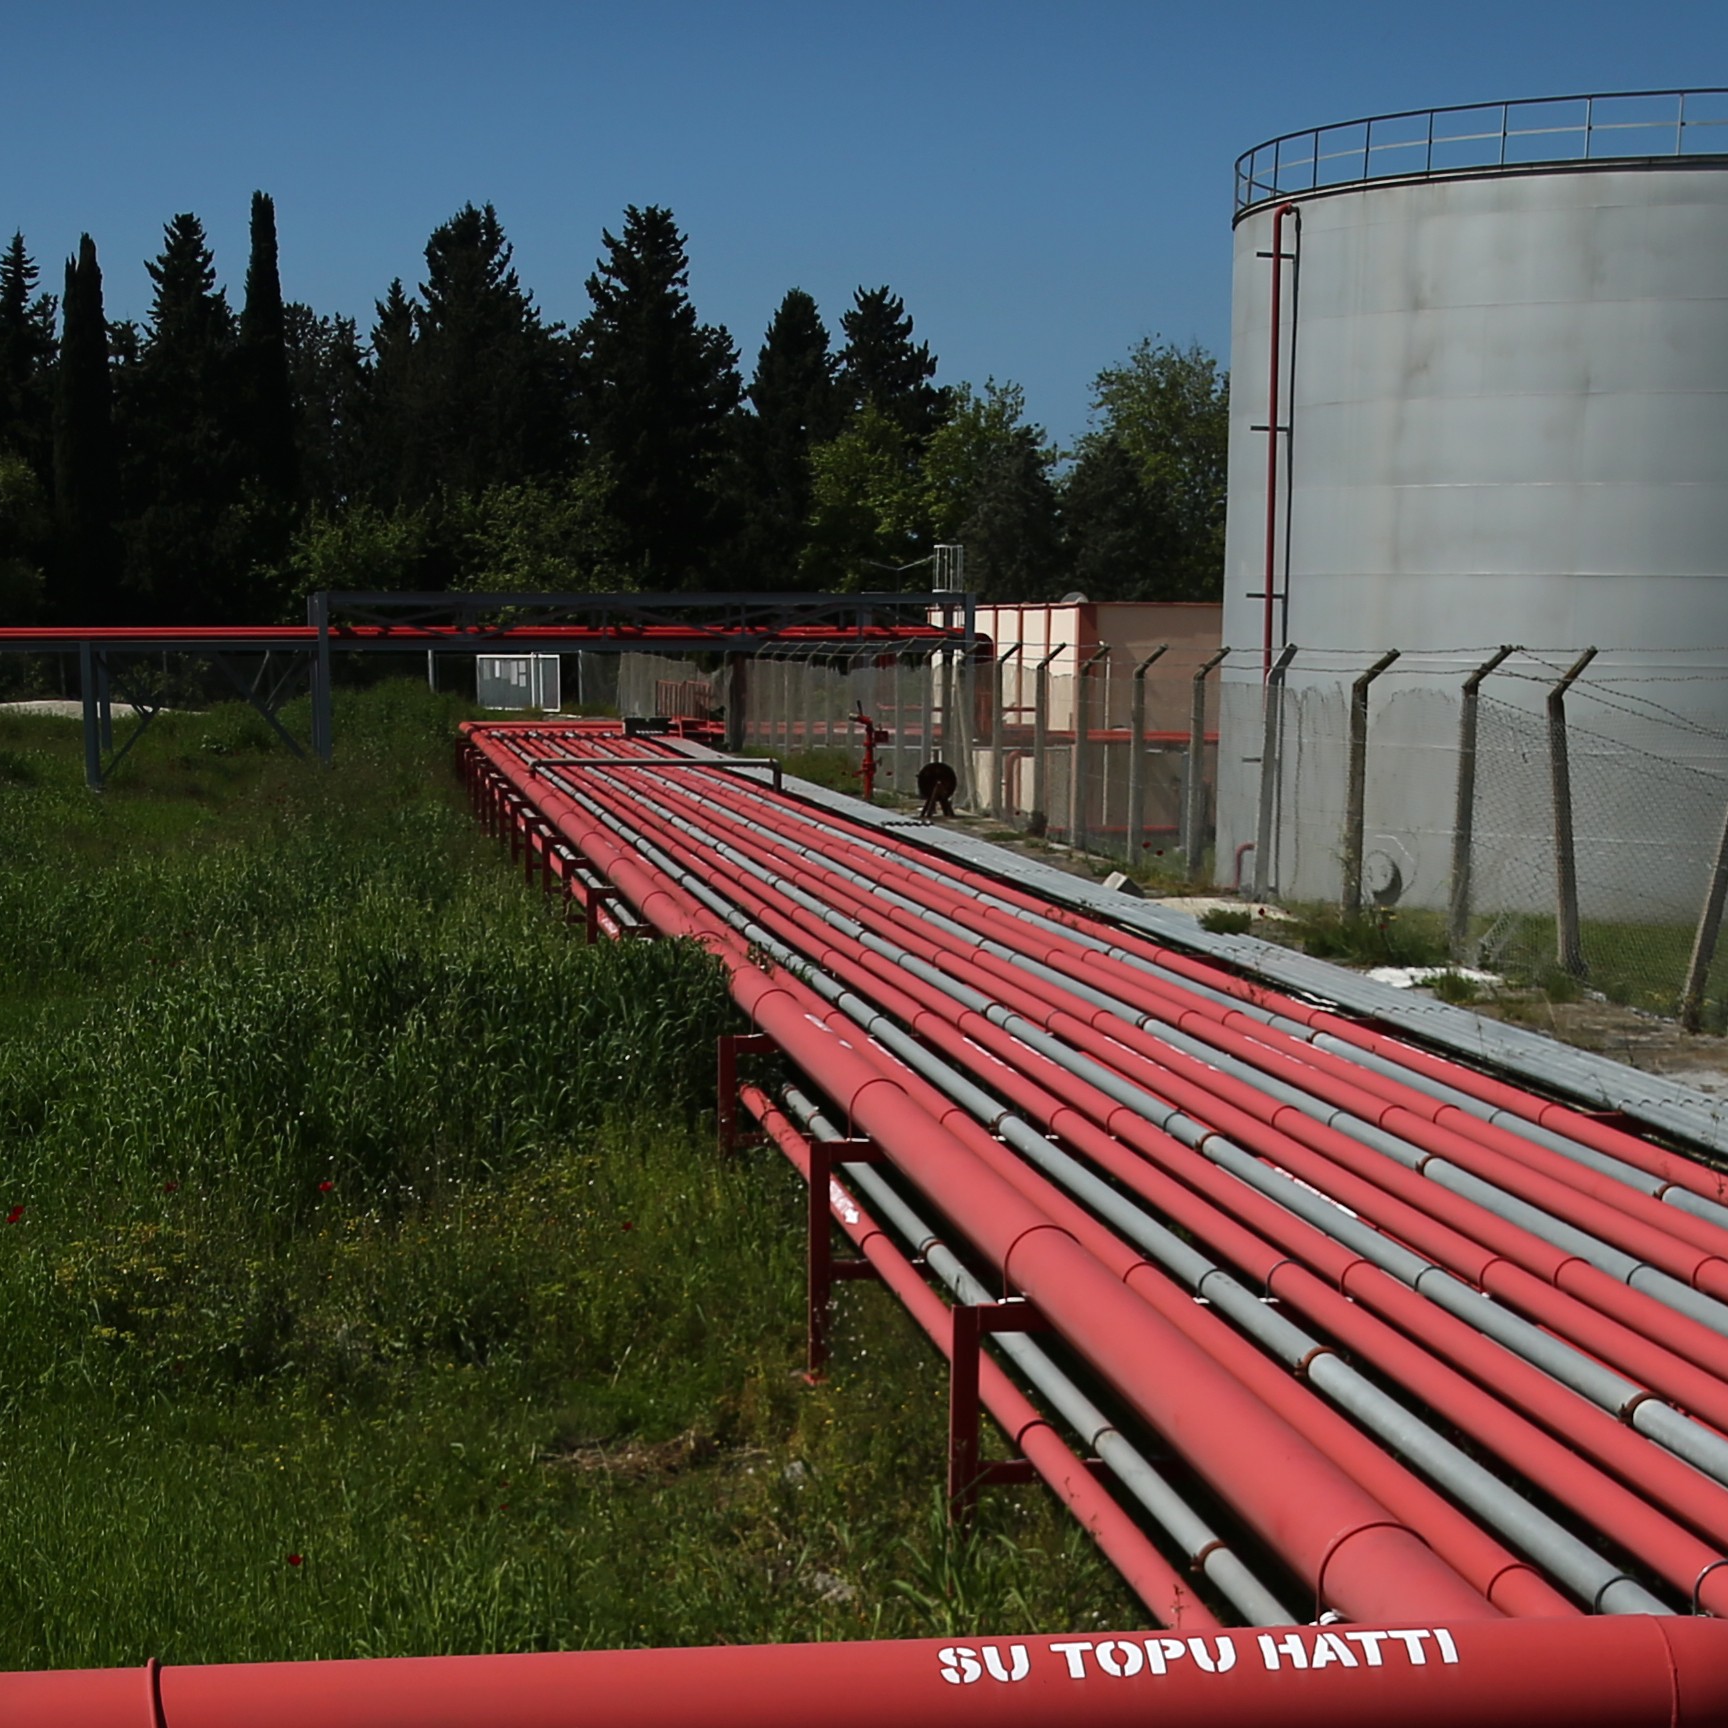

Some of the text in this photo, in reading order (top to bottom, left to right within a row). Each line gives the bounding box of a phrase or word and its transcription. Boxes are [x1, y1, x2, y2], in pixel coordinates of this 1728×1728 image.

[938, 1628, 1459, 1684] SU TOPU HATTI
